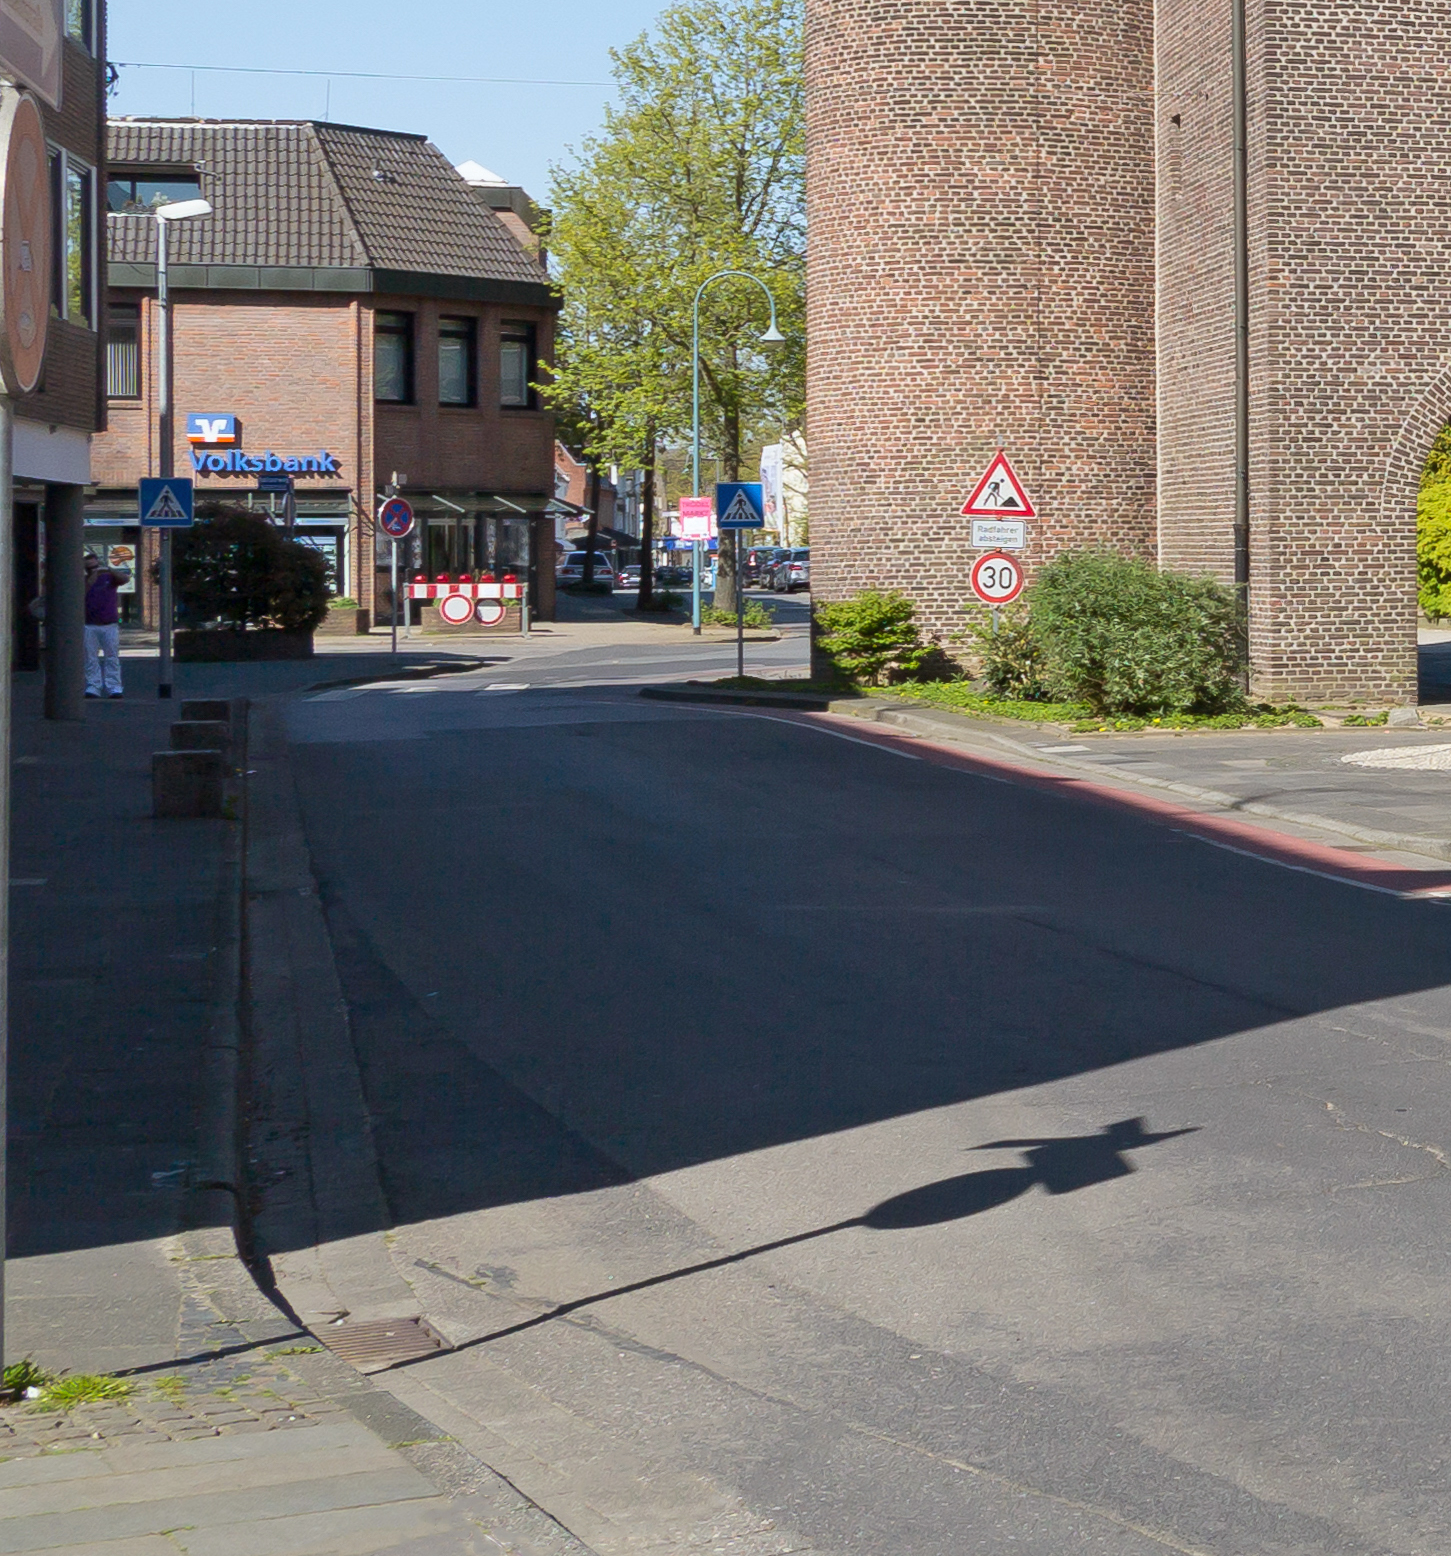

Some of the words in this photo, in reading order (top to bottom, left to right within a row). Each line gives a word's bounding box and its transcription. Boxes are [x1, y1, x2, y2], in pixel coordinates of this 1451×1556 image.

[187, 448, 337, 473] Volksbank
[977, 525, 1019, 534] Radfahrer
[982, 565, 1013, 590] 30
